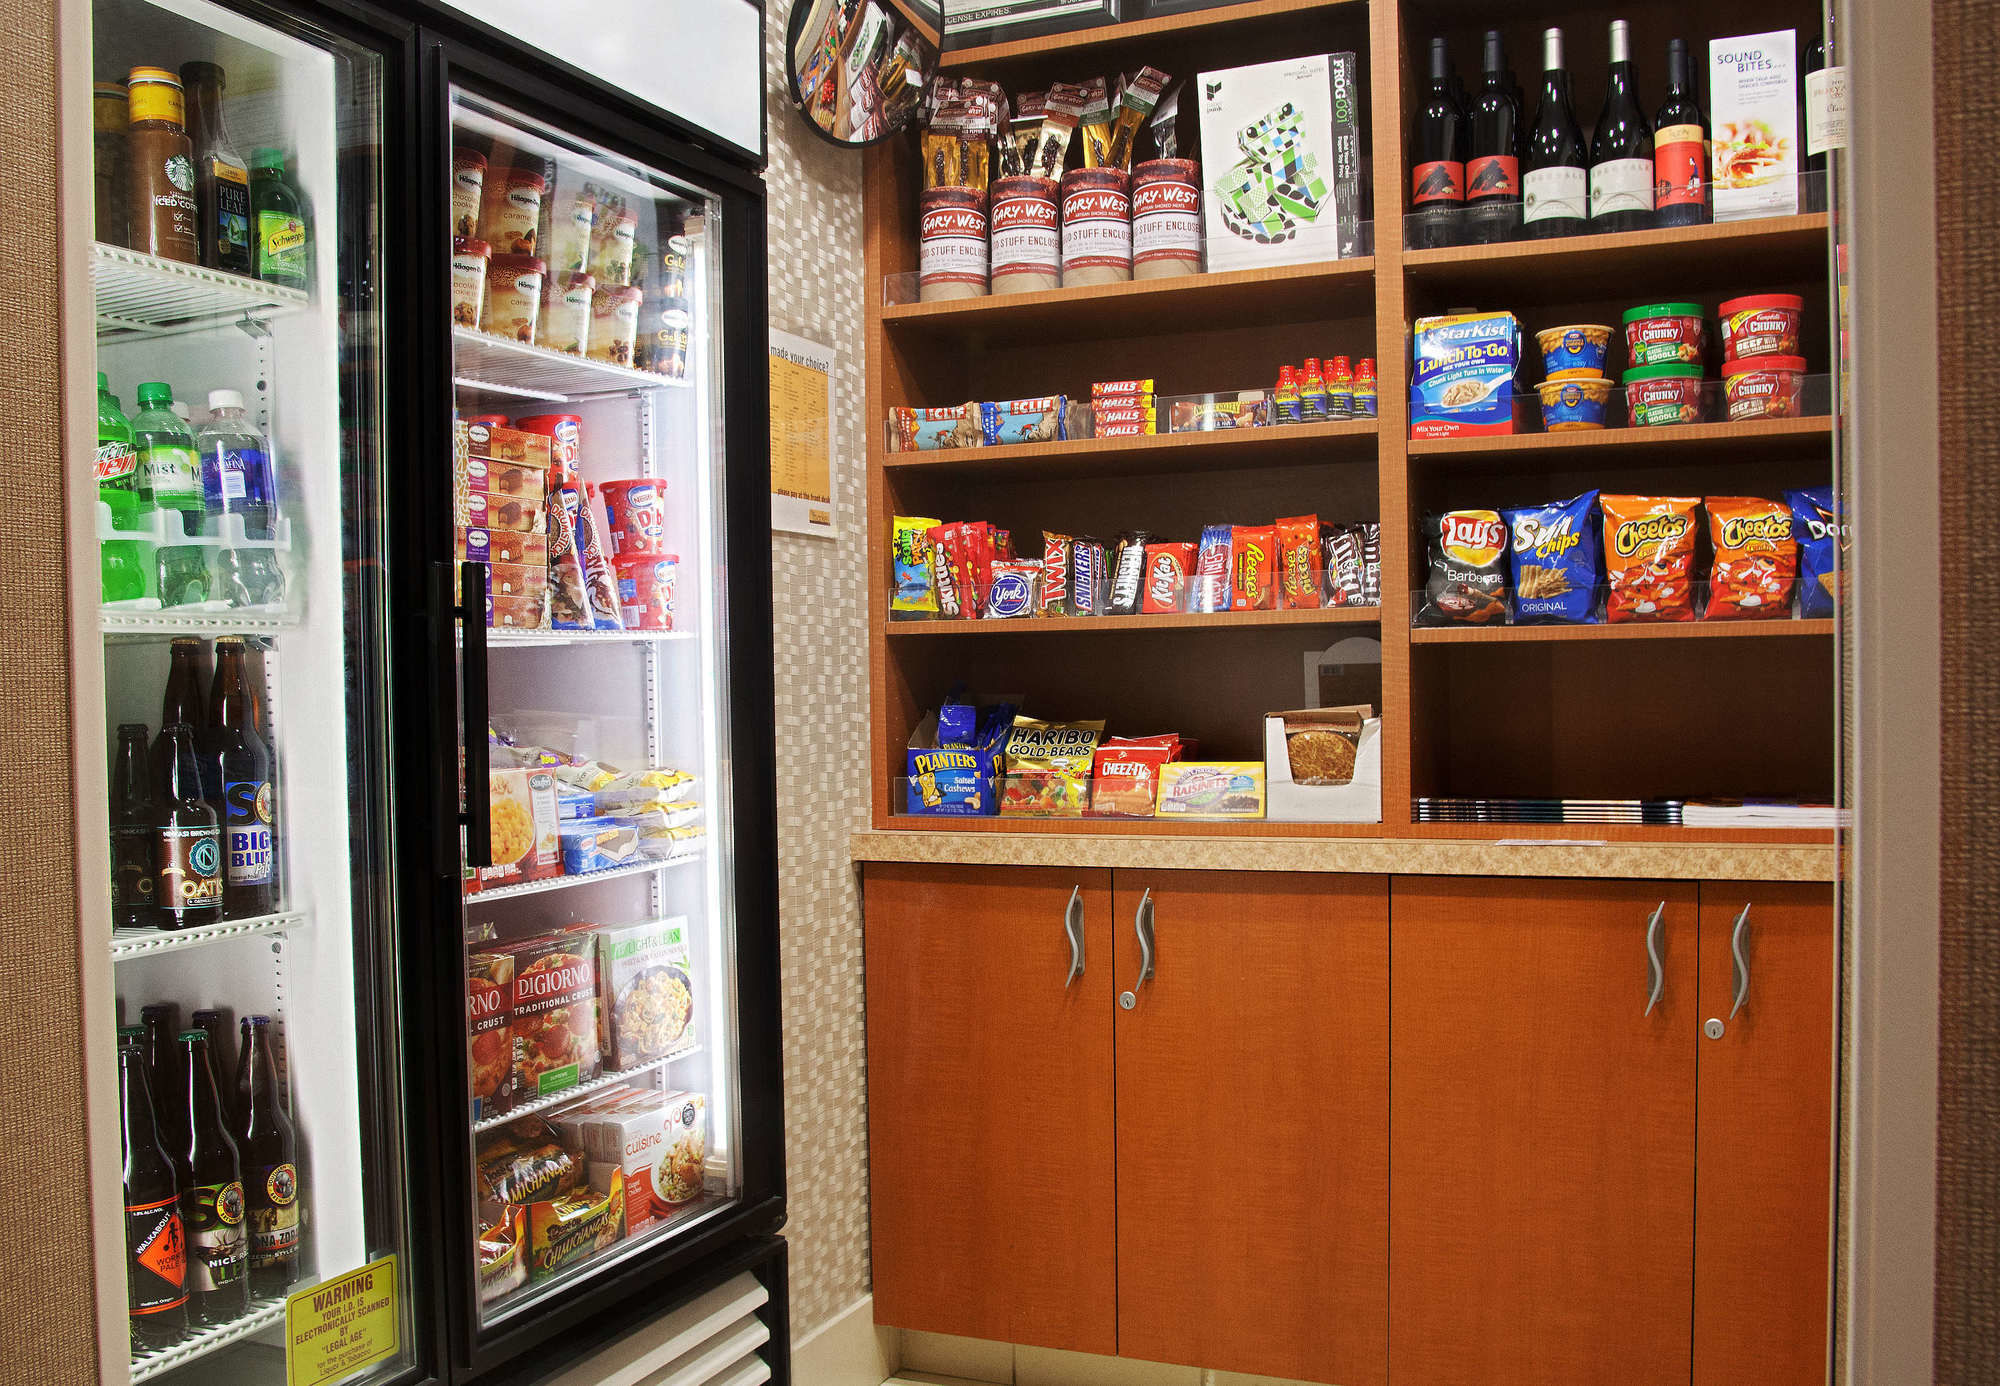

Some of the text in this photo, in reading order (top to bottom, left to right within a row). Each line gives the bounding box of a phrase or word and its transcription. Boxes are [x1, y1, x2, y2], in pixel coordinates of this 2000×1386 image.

[976, 7, 1012, 20] EXPIRES:
[1717, 50, 1762, 65] SOUND
[1737, 58, 1773, 73] BITES
[1133, 187, 1198, 208] GARY WEST
[992, 203, 1057, 225] GARY WEST
[1065, 195, 1130, 218] GARY WEST
[923, 214, 986, 233] GARY WEST
[1139, 221, 1163, 234] STUFF
[1000, 236, 1026, 248] STUFF
[1073, 228, 1100, 241] STUFF
[931, 245, 957, 258] STUFF
[1438, 323, 1507, 341] StarKist
[1642, 327, 1679, 341] CHUNKY
[1750, 321, 1787, 333] CHUNKY
[790, 351, 804, 365] your
[806, 355, 830, 373] choice?
[1486, 367, 1505, 375] Water
[1103, 382, 1137, 394] HALLS
[1643, 390, 1680, 403] CHUNKY
[1738, 383, 1775, 397] CHUNKY
[1018, 401, 1051, 414] CLIF
[1102, 398, 1137, 409] HALLS
[934, 407, 965, 419] CLIF
[1105, 410, 1140, 422] HALLS
[1105, 425, 1140, 437] HALLS
[1416, 425, 1429, 433] Mix
[1443, 424, 1460, 432] Own
[550, 504, 571, 558] DRUMSTICK
[1444, 518, 1504, 550] Lay's
[1513, 515, 1573, 553] Sun
[1616, 515, 1687, 557] Cheetos
[1722, 515, 1792, 549] Cheetos
[901, 529, 913, 566] SOUR
[1536, 531, 1581, 558] Chips
[1041, 537, 1067, 610] TWIX
[1075, 544, 1092, 608] SNICKERS
[1246, 542, 1265, 600] Reese's
[993, 582, 1022, 607] York
[1521, 601, 1568, 613] ORIGINAL
[1012, 728, 1095, 745] HARIBO
[1009, 744, 1091, 757] GOLD-BEARS
[914, 752, 977, 774] PLANTERS
[943, 784, 976, 793] Cashews
[953, 776, 976, 785] Salted
[1173, 777, 1229, 797] RAISINETS
[231, 830, 270, 851] BIG
[514, 987, 593, 1016] TRADITIONAL CRUST
[477, 1015, 504, 1032] CRUST
[625, 1133, 662, 1156] cuisine
[136, 1211, 172, 1254] WALKABOUT
[543, 1212, 610, 1270] CHIMICHANGAS
[209, 1254, 237, 1269] NICE
[313, 1273, 373, 1313] WARNING
[322, 1305, 341, 1322] YOUR
[357, 1296, 364, 1307] IS
[295, 1297, 390, 1346] ELECTRONICALLY SCANNED
[340, 1325, 348, 1337] BY
